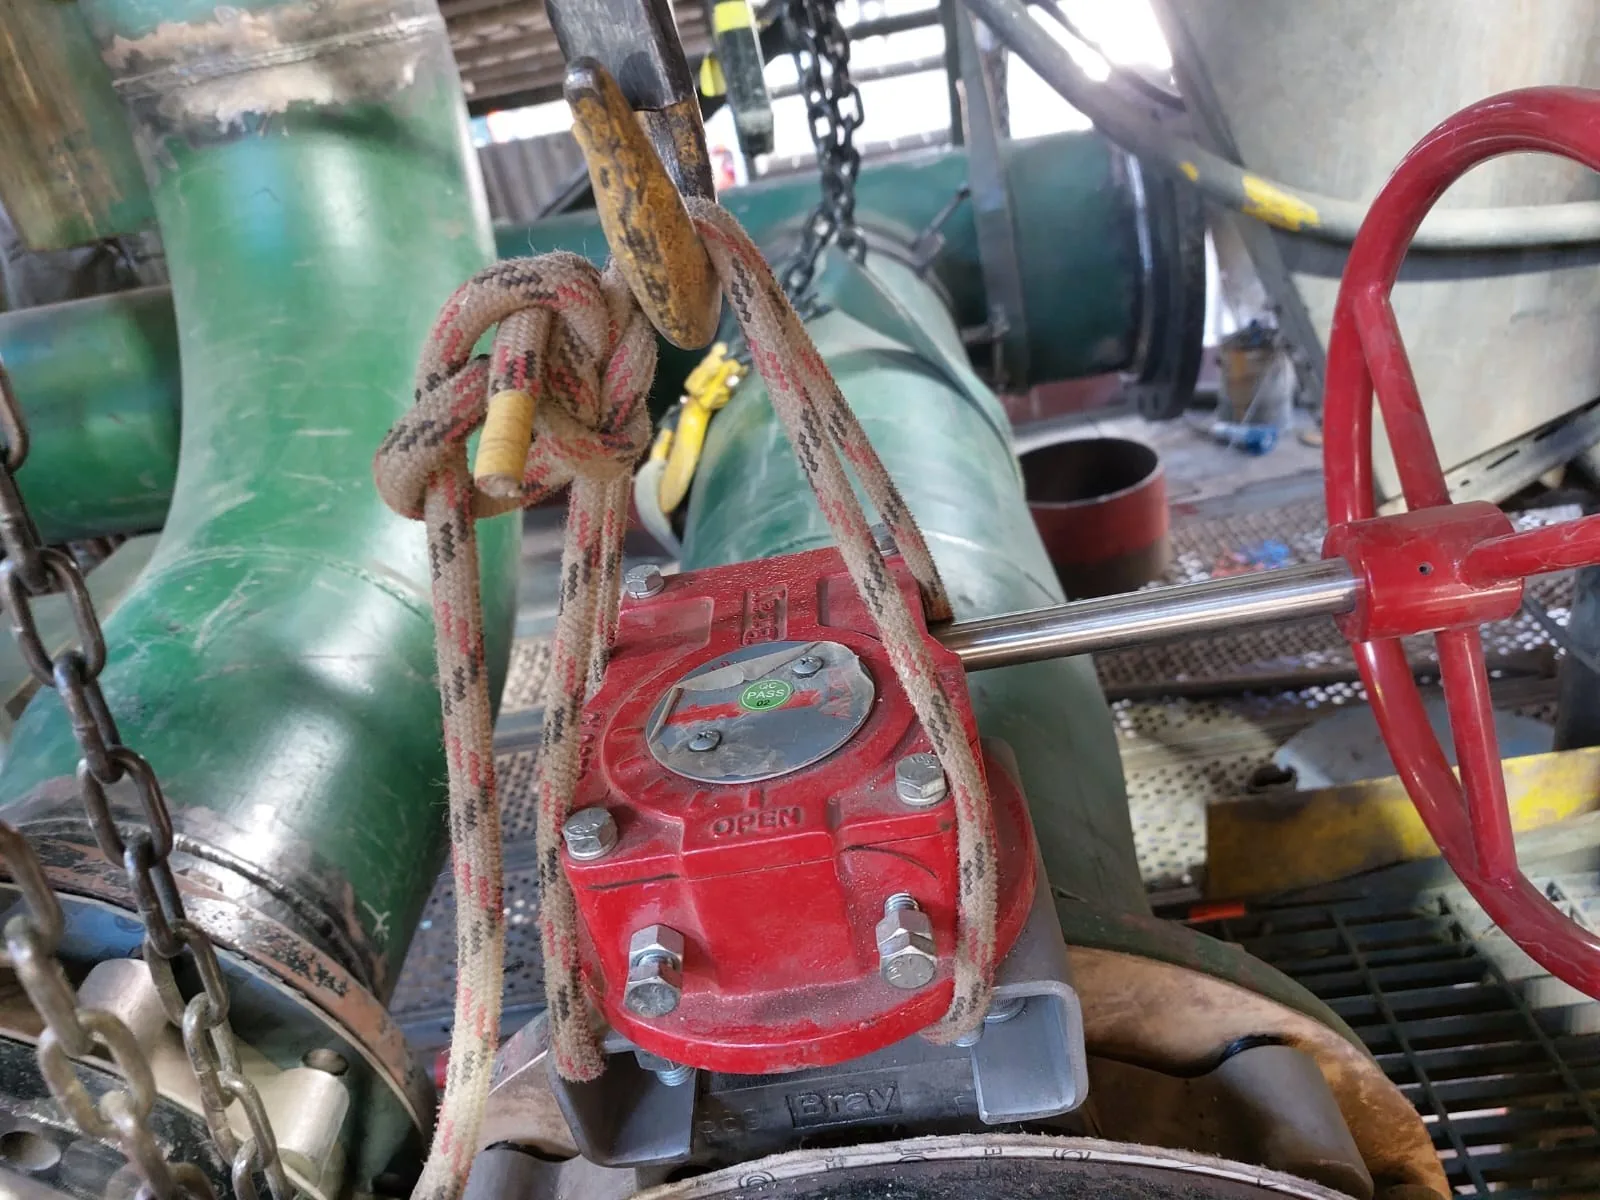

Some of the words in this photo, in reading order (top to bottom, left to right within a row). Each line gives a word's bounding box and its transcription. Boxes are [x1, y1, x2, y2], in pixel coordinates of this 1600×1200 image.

[747, 689, 785, 700] PASS
[759, 682, 777, 690] QC
[712, 806, 803, 837] OPEN
[797, 1081, 898, 1117] Bray
